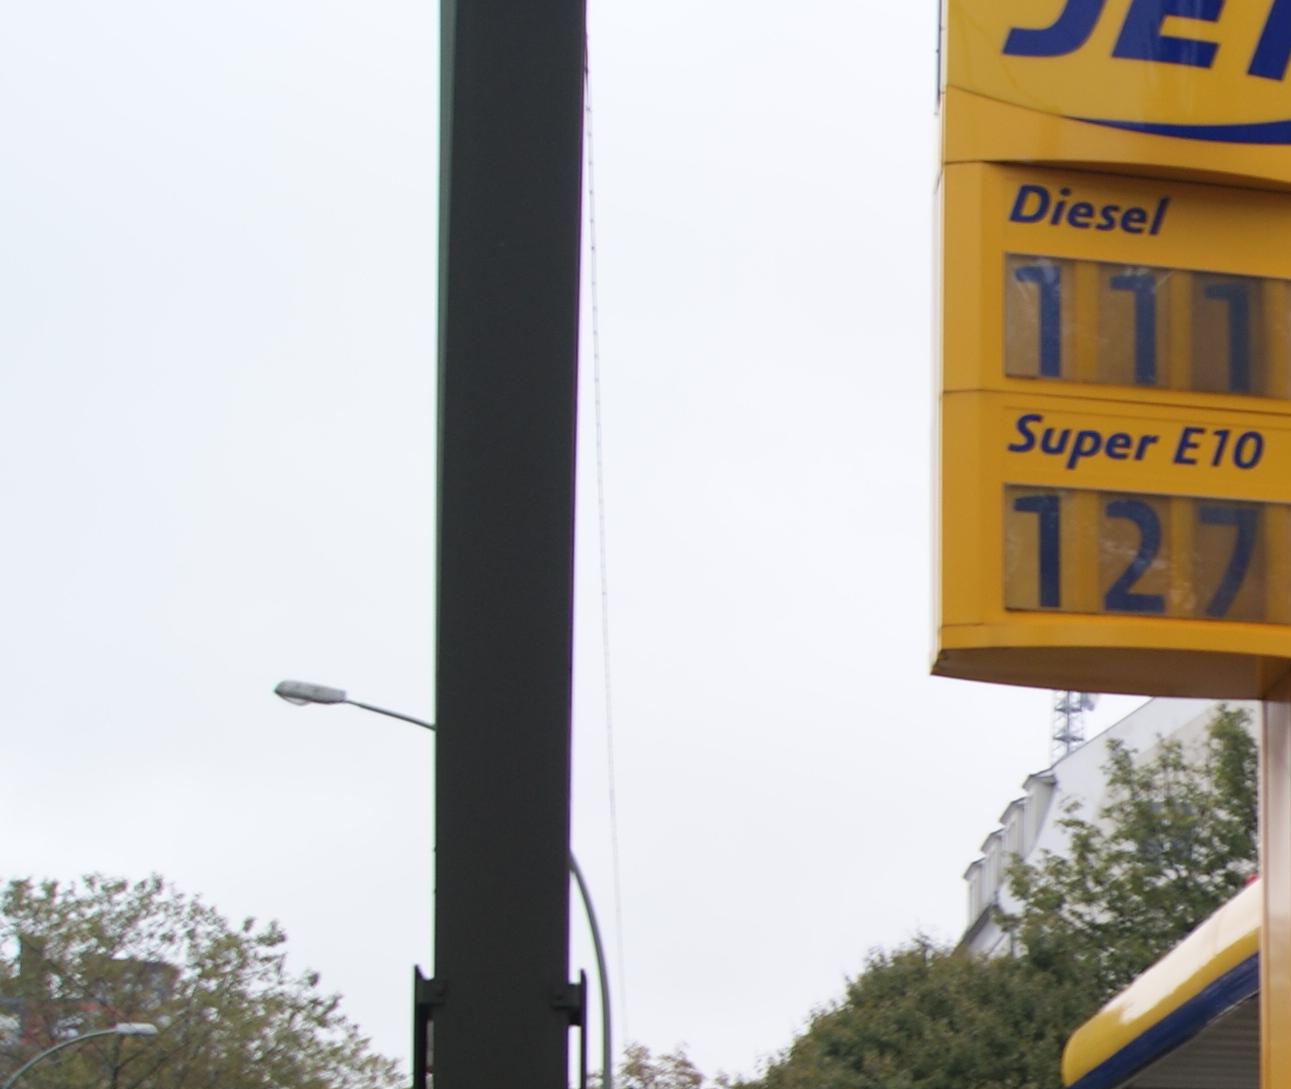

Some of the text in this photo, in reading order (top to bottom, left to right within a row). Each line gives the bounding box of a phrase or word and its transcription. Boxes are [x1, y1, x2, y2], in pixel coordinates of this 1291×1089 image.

[1009, 184, 1169, 236] Diesel
[1007, 414, 1265, 479] Super E10
